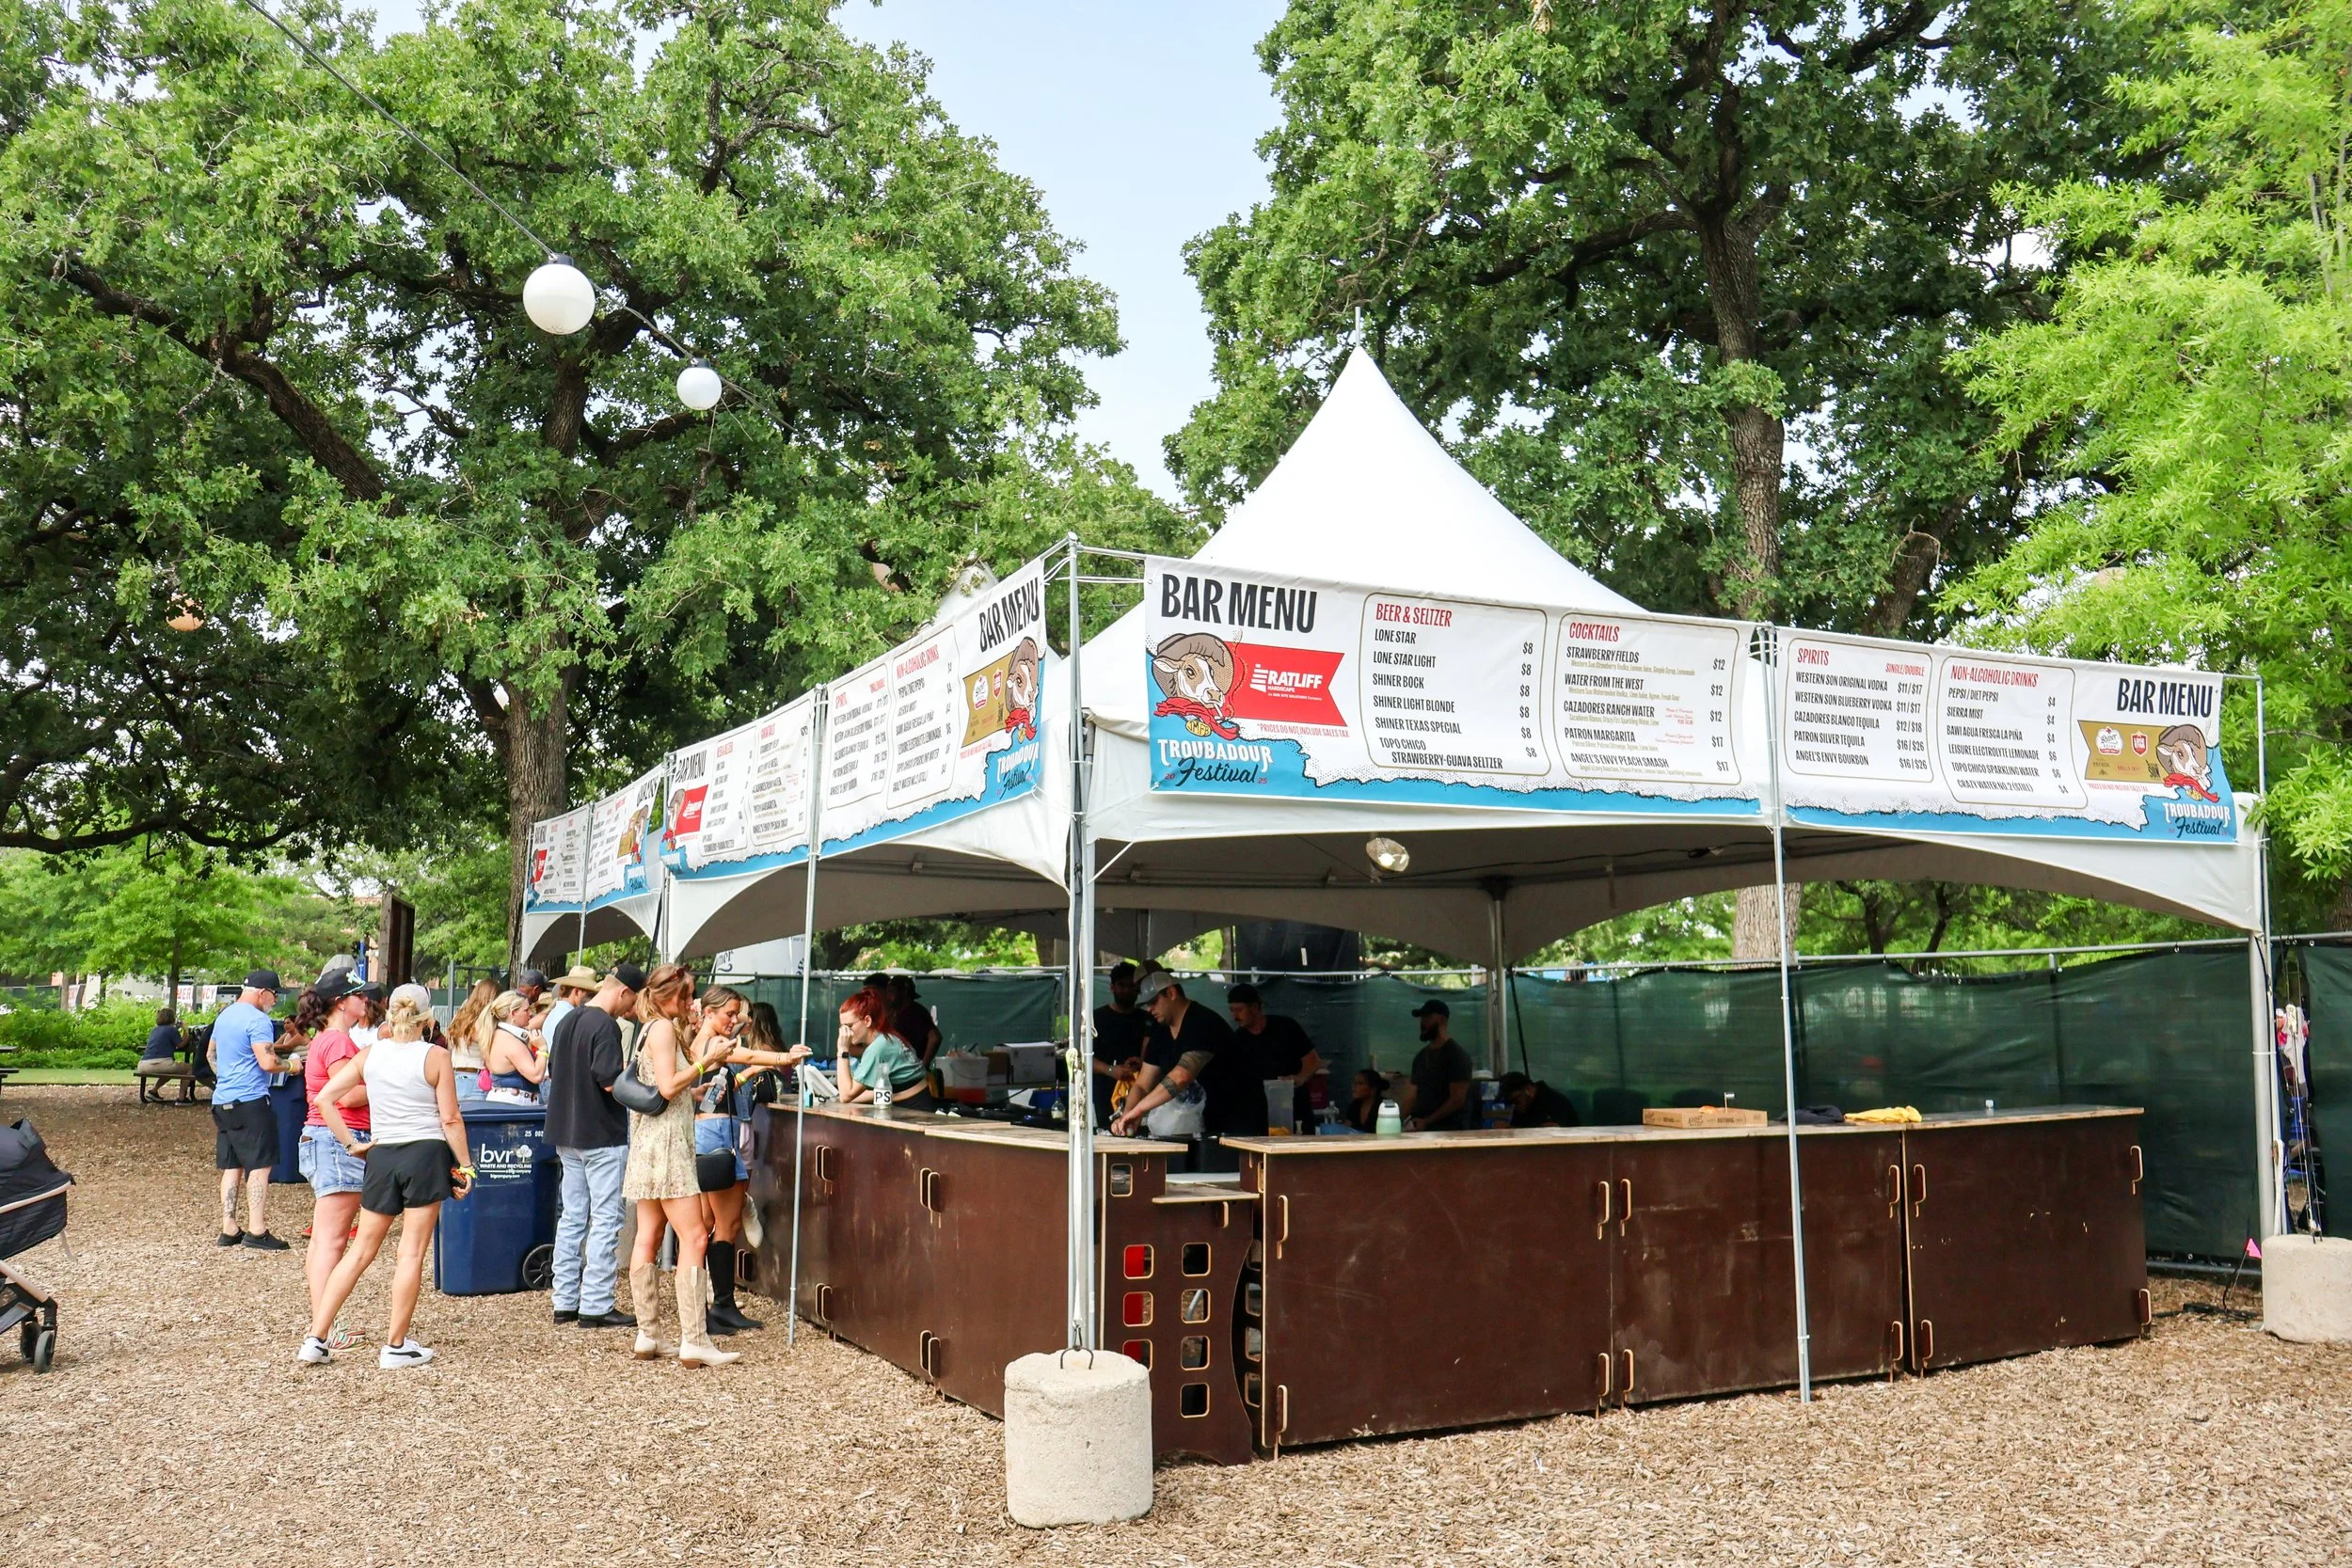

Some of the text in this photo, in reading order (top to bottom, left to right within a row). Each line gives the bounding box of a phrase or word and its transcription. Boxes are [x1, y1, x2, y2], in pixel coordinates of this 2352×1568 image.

[1161, 573, 1317, 633] BAR MENU
[978, 578, 1039, 653] BAR MENU
[1375, 603, 1453, 626] BEER & SELTZER
[1375, 628, 1417, 645] LONE STAR
[1569, 623, 1620, 641] COCKTAILS
[1522, 641, 1534, 655] $8
[1566, 646, 1639, 663] STRAWBERRY FIELDS
[1374, 651, 1436, 668] LONE STAR LIGHT
[1712, 658, 1725, 671] $12
[1798, 648, 1829, 666] SPIRITS
[1521, 663, 1532, 675] $8
[1885, 663, 1925, 676] SINGLE/DOUBLE
[1950, 665, 2039, 688] NON-ALCOHOLIC DRINKS
[1267, 670, 1323, 689] RATLIFF
[1373, 673, 1424, 689] SHINER BOCK
[1565, 673, 1645, 690] WATER FROM THE WEST
[1796, 672, 1887, 691] WESTERN SON ORIGINAL VODKA
[1520, 685, 1530, 697] $8
[1710, 685, 1723, 696] $12
[1898, 683, 1922, 695] $11 $17
[1948, 688, 1999, 703] PEPSI DIET PEPSI
[1374, 695, 1454, 713] SHINER LIGHT BLONDE
[1795, 691, 1892, 711] WESTERN SON BLUEBERRY VODKA
[2047, 696, 2056, 707] $4
[2117, 678, 2213, 718] BAR MENU
[1520, 706, 1530, 719] $8
[1564, 700, 1605, 714] CAZADORES
[1606, 704, 1630, 716] RANCH
[1631, 705, 1655, 718] WATER
[1897, 702, 1921, 714] $11 $17
[1947, 706, 1983, 720] SIERRA MIST
[1710, 711, 1722, 722] $12
[1794, 711, 1880, 730] CAZADORES BLANCO TEQUILA
[1281, 725, 1289, 734] DO
[1289, 726, 1298, 735] NOT
[1299, 727, 1323, 736] INCLUDE
[1323, 728, 1339, 737] SALES
[1375, 717, 1462, 734] SHINER TEXAS SPECIAL
[1520, 726, 1532, 739] $8
[1897, 721, 1922, 733] $12 $18
[1963, 726, 1979, 737] AGUA
[1979, 728, 2000, 739] FRESCA
[2001, 730, 2009, 739] LA
[1565, 727, 1635, 742] PATRON MARGARITA
[1712, 736, 1724, 748] $17
[1794, 730, 1865, 748] PATRON SILVER TEQUILA
[1379, 737, 1426, 751] TOPO CHICO
[1897, 739, 1925, 752] $16 $26
[1948, 743, 2040, 760] LEISURE ELECTROLYTE LEMONADE
[1157, 739, 1273, 772] TROUBADOUR
[1526, 747, 1537, 757] $8
[1795, 751, 1869, 766] ANGEL'S ENVY BOURBON
[2049, 752, 2057, 761] $6
[1392, 752, 1503, 769] STRAWBERRY-GUAVA SELTZER
[1571, 752, 1669, 768] ANGEL'S ENVY PEACH SMASH
[1716, 761, 1729, 772] $17
[1899, 758, 1928, 769] $16 $26
[1176, 757, 1259, 786] Festival
[1951, 762, 2040, 777] TOPO CHICO SPARKLING WATER
[2052, 768, 2061, 779] $6
[1957, 779, 1977, 789] CRAZY
[1977, 781, 1997, 790] WATER
[2163, 802, 2231, 828] TROUBADOUR
[2176, 817, 2222, 838] Festival
[875, 1091, 891, 1102] PS
[480, 1144, 514, 1164] bvr
